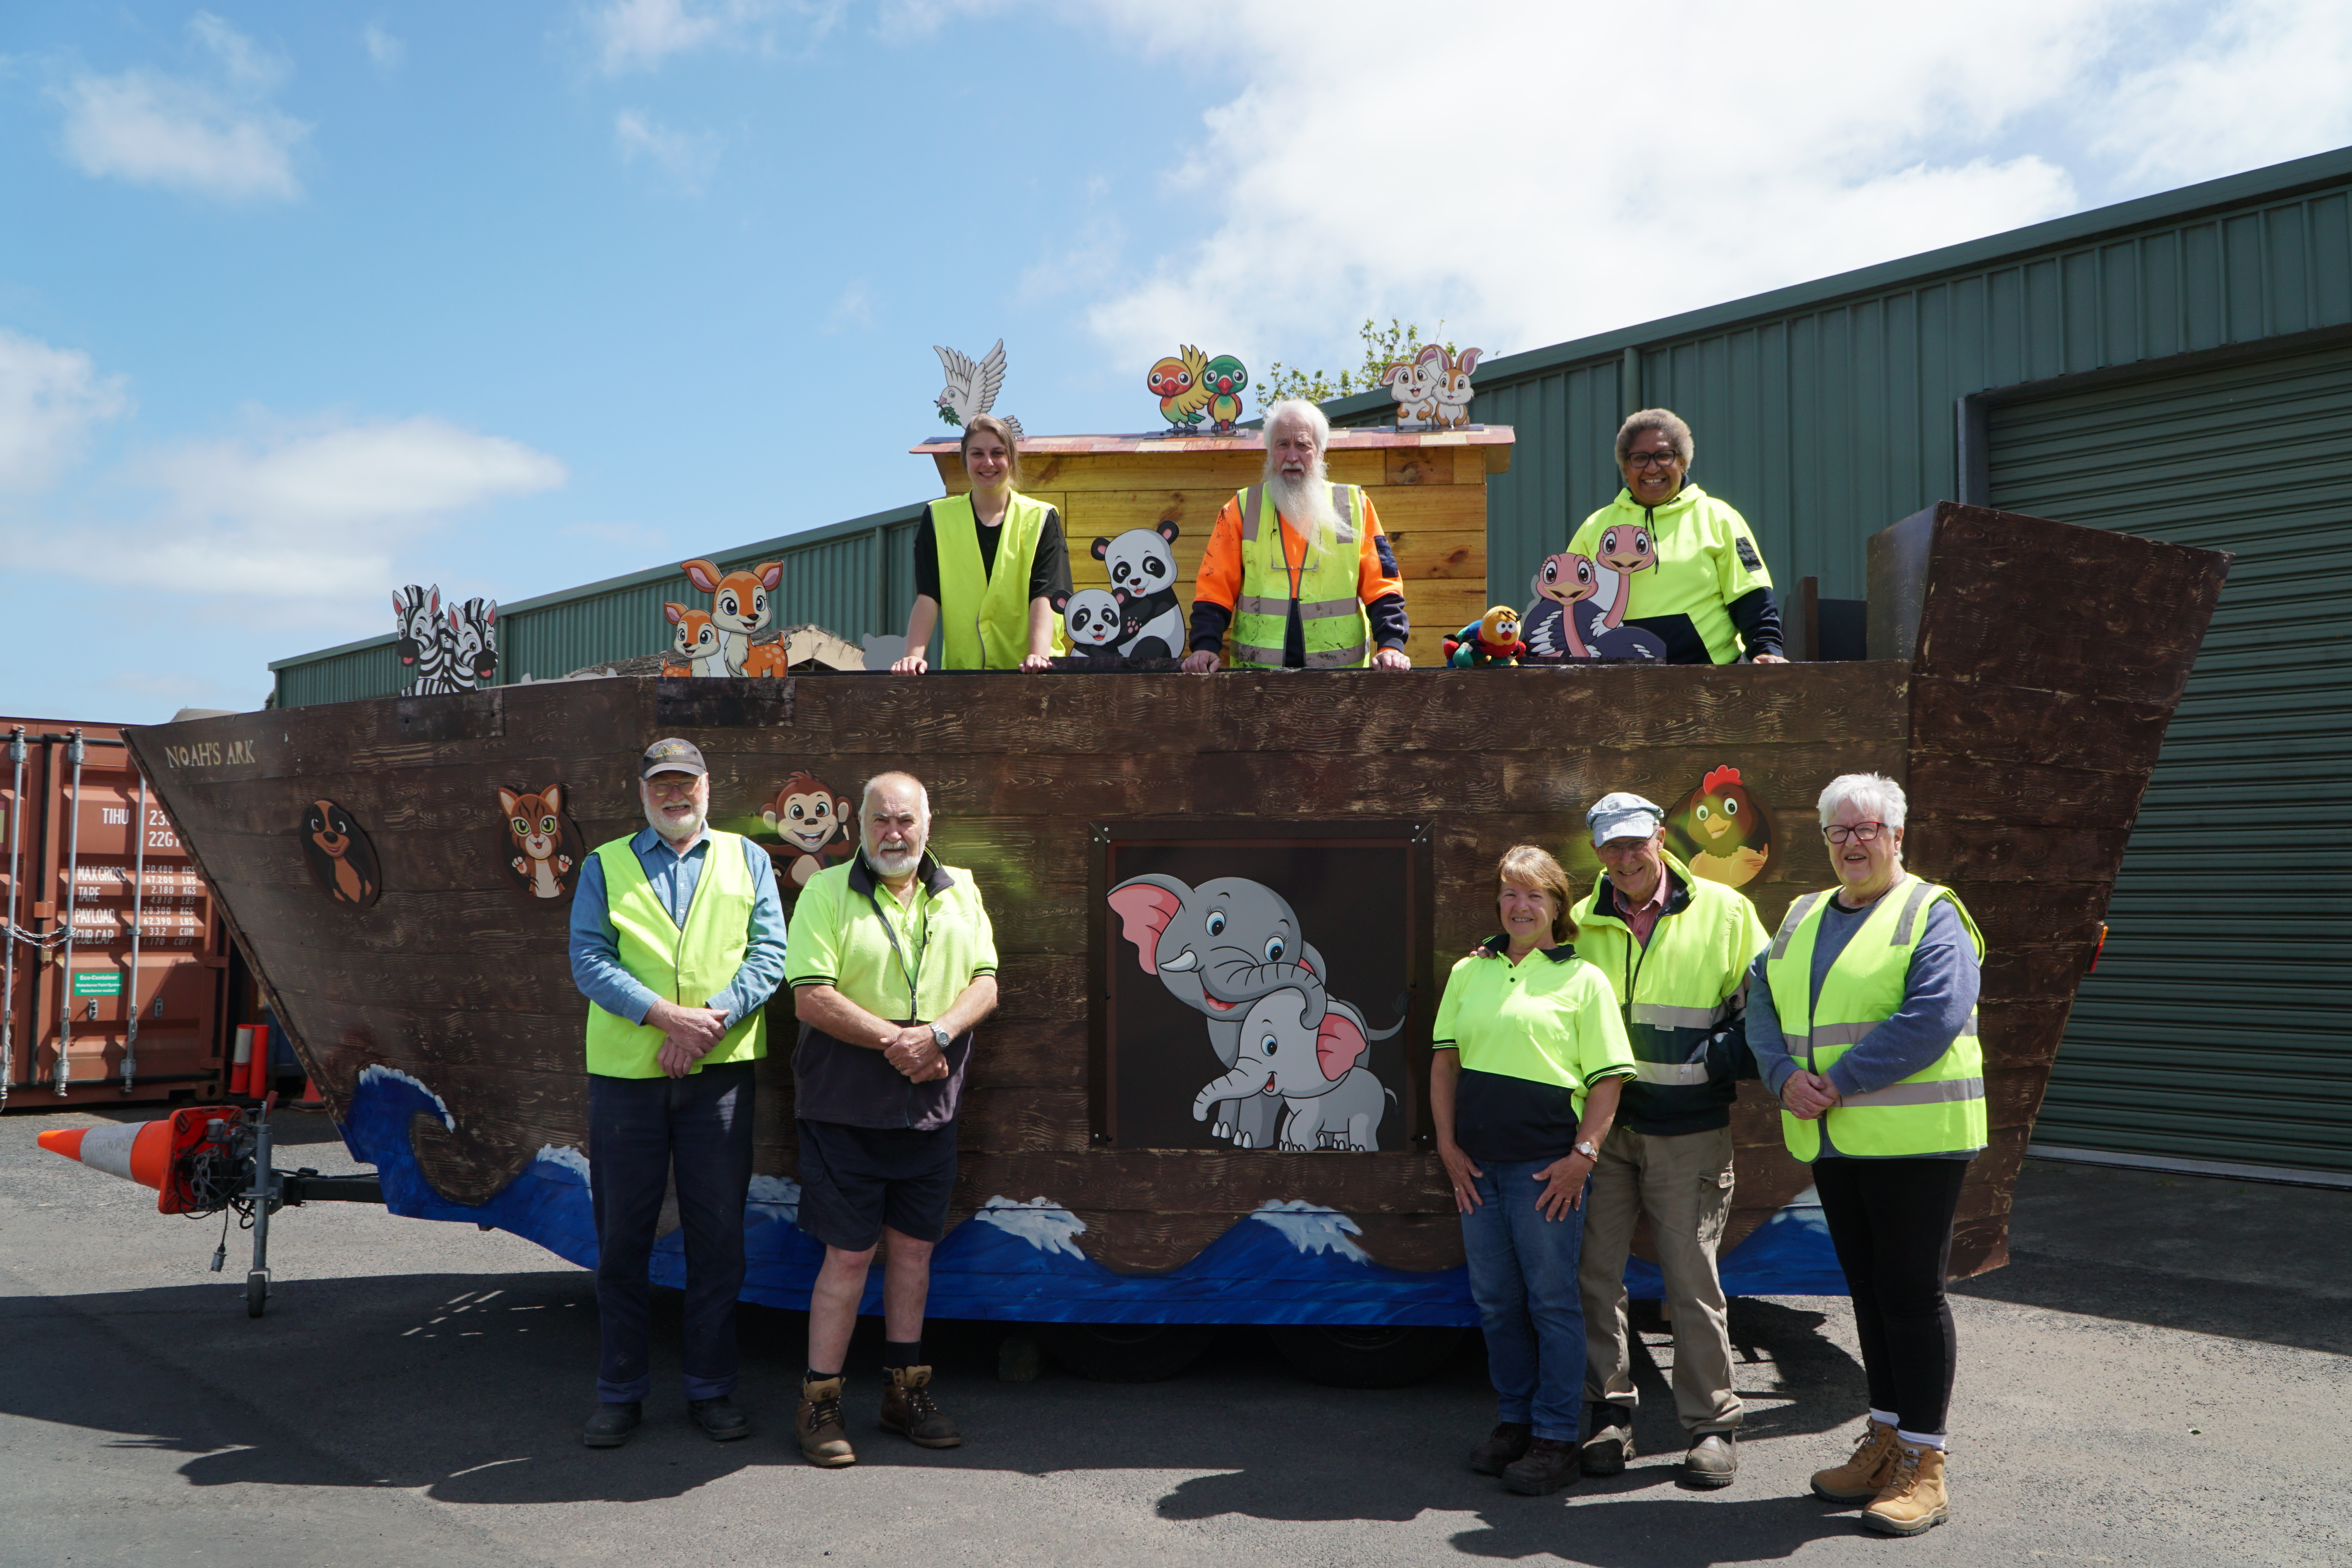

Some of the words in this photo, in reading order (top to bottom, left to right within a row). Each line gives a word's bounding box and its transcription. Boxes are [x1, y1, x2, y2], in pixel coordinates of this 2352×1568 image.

[165, 742, 221, 768] NOAH'S
[227, 740, 256, 764] ARK
[102, 808, 129, 824] TIHU
[149, 810, 170, 826] 23
[78, 866, 98, 881] MAX
[98, 866, 126, 882] GROSS
[145, 865, 173, 873] 30.480
[182, 866, 196, 874] KGS
[78, 886, 100, 902] TARE
[151, 886, 174, 894] 2.180
[183, 886, 196, 895] KGS
[75, 908, 115, 924] PAYLOAD
[180, 907, 194, 915] KGS
[149, 927, 166, 936] 33.2
[179, 928, 194, 936] CUM
